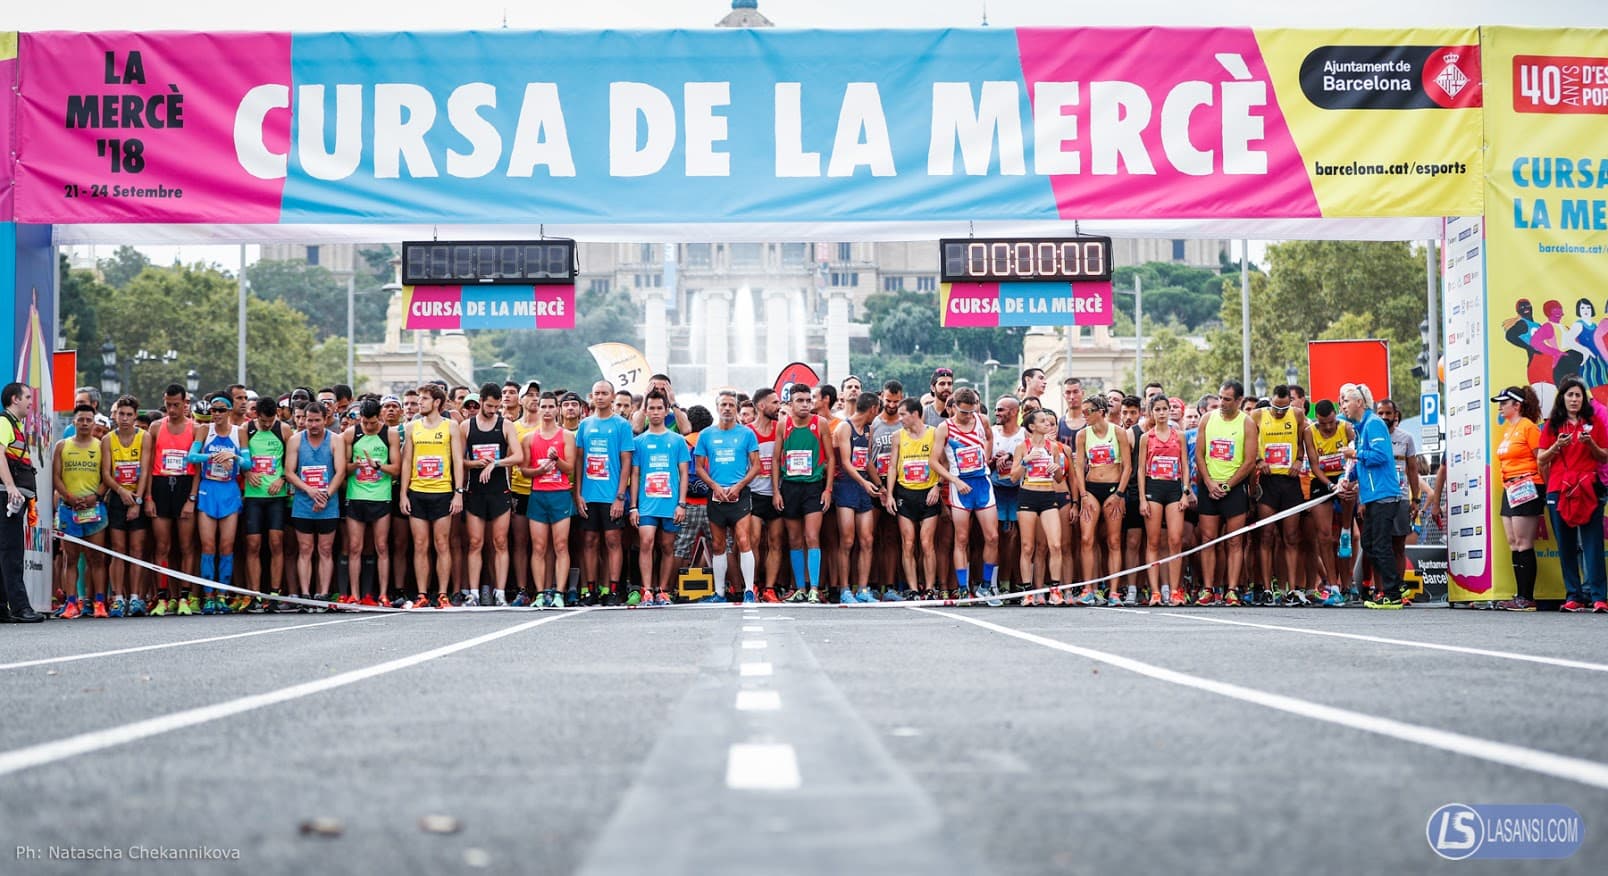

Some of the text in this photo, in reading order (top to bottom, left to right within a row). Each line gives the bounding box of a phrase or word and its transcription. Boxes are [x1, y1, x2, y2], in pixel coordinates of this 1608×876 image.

[105, 50, 146, 85] LA
[1323, 60, 1411, 75] Ajuntament de
[1323, 77, 1412, 91] Barcelona
[1520, 64, 1560, 105] 40
[1562, 65, 1580, 106] ANYS
[66, 84, 184, 128] MERCÈ
[233, 52, 1268, 180] CURSA DE LA MERCÈ
[97, 138, 144, 174] '18
[1315, 162, 1466, 177] barcelona.cat/esports
[1512, 157, 1608, 188] CURSA
[64, 184, 78, 198] 21
[90, 184, 108, 198] 24
[112, 184, 183, 199] Setembre
[1514, 198, 1608, 230] LA ME
[968, 242, 1103, 276] 00:00:00
[412, 296, 565, 316] CURSA DE LA MERCÈ
[951, 293, 1102, 313] CURSA DE LA MERCÈ
[1424, 397, 1436, 422] P
